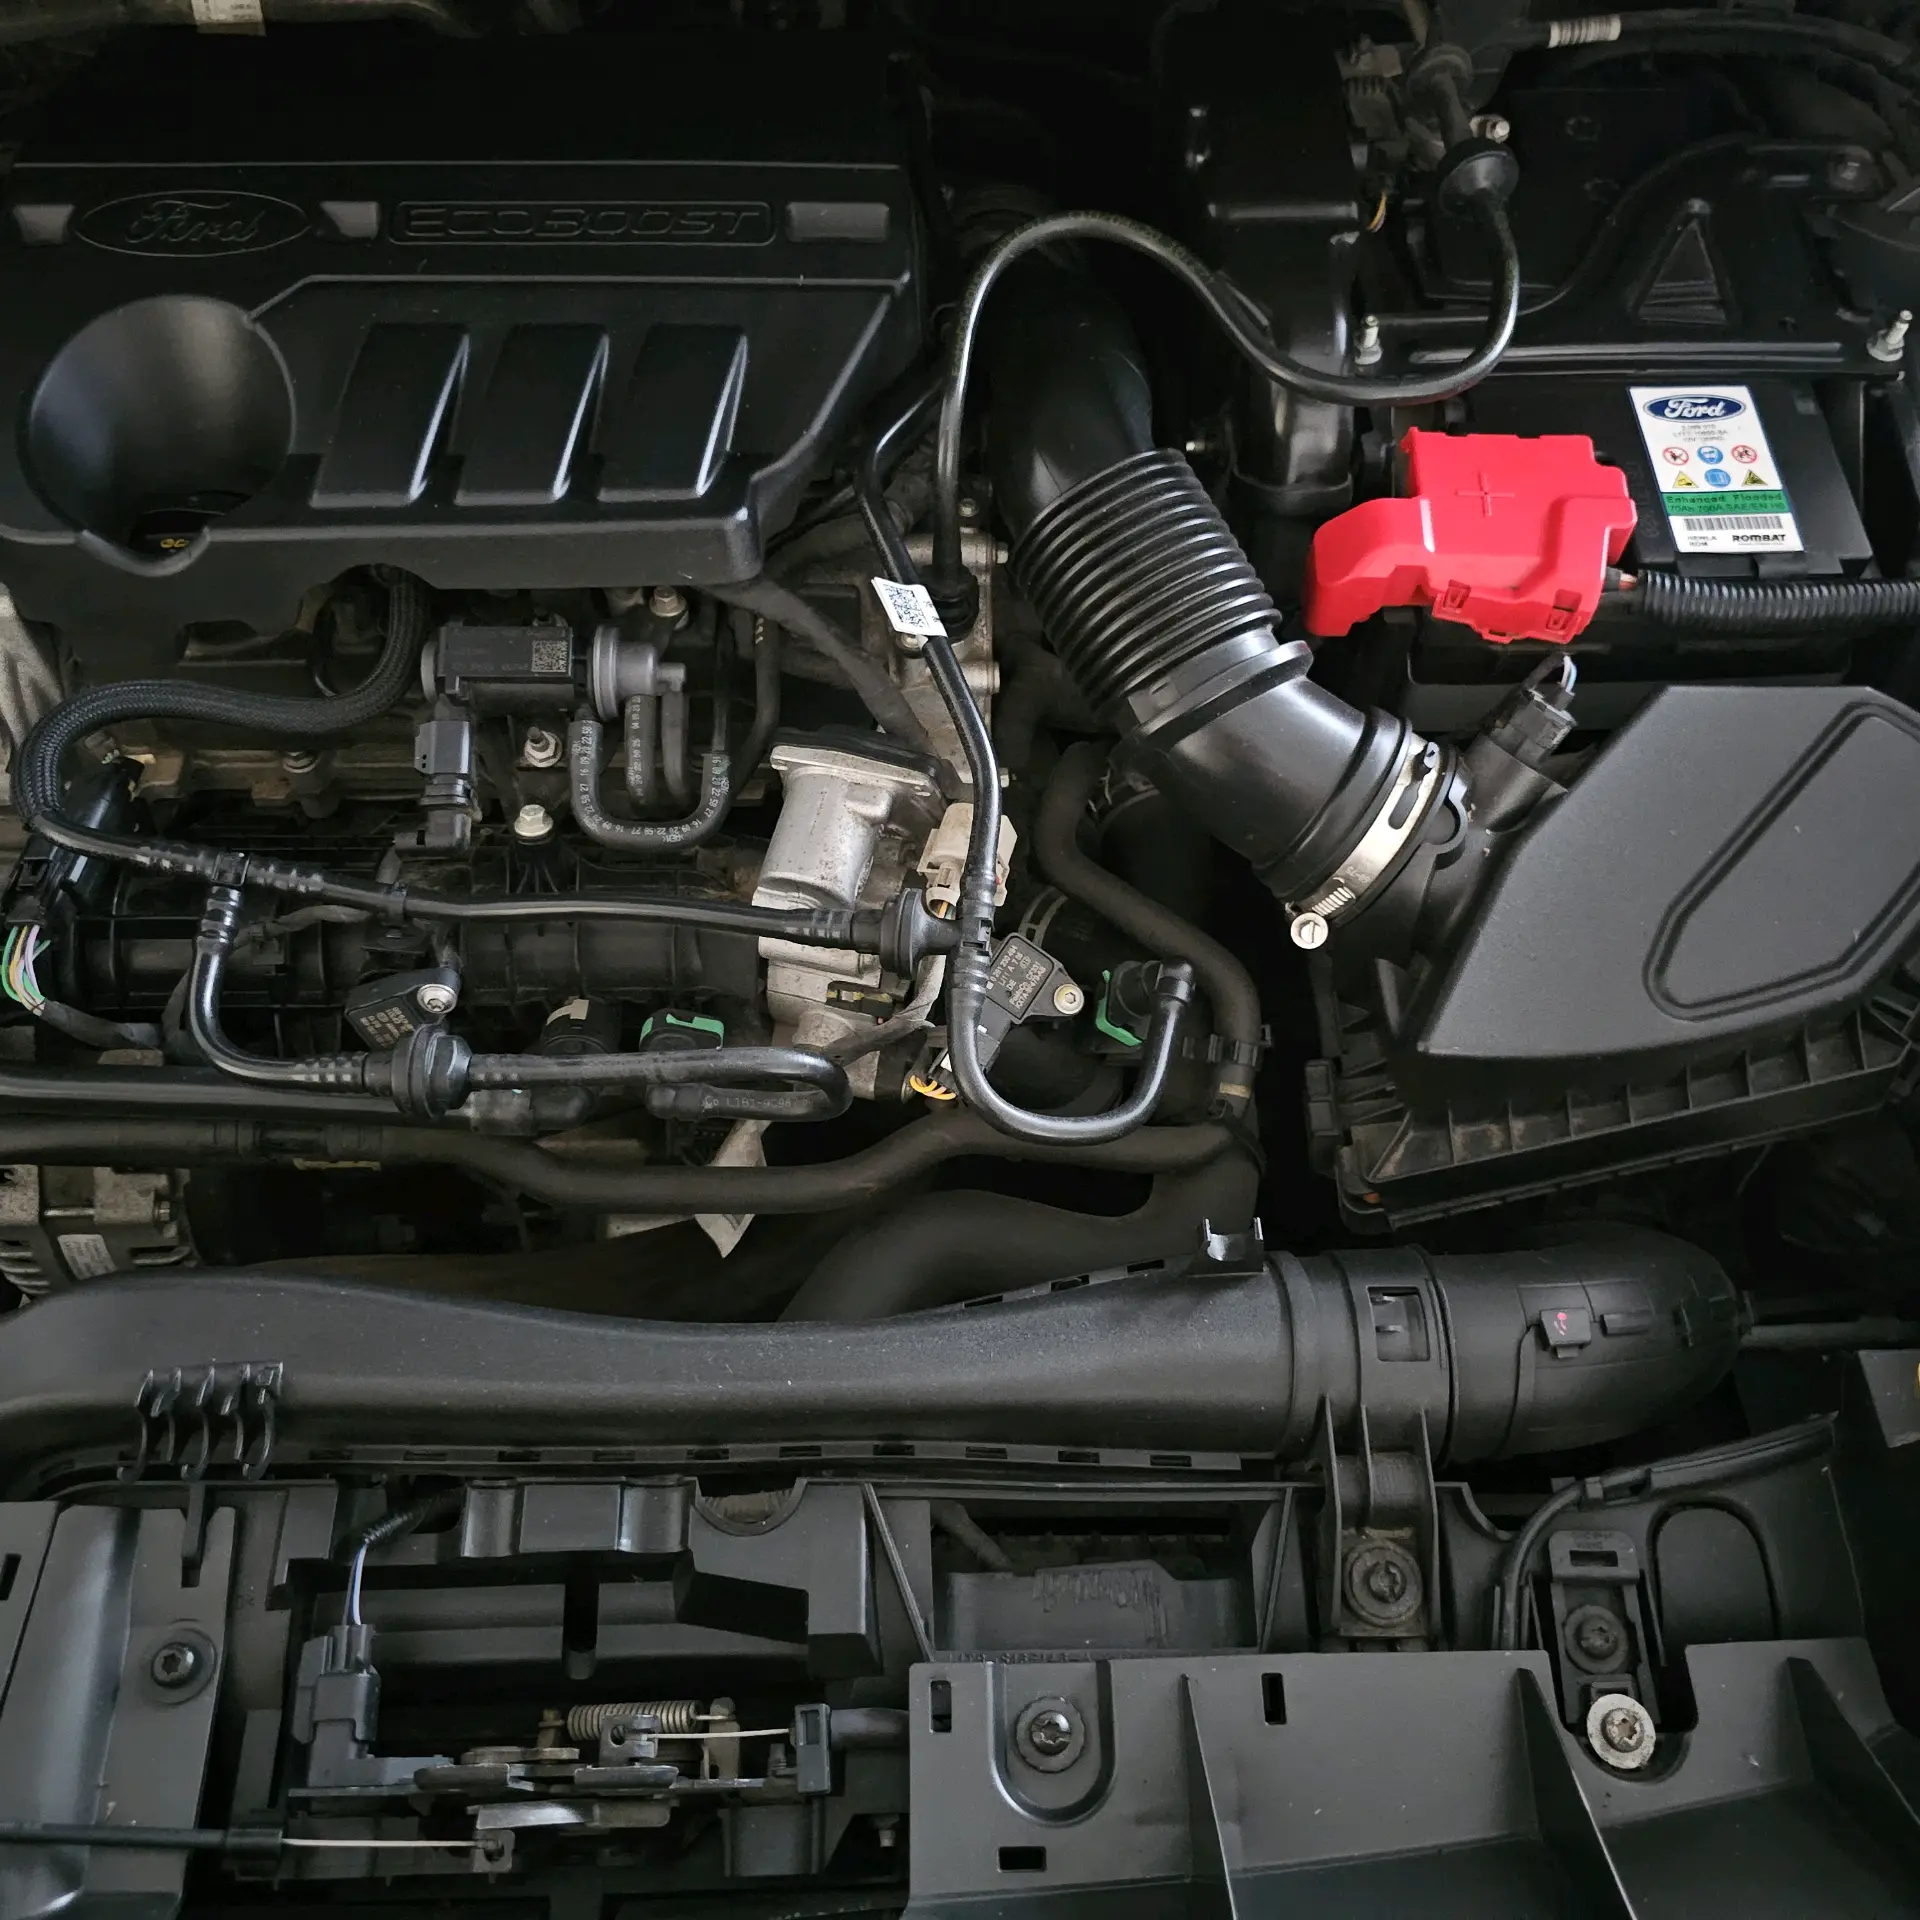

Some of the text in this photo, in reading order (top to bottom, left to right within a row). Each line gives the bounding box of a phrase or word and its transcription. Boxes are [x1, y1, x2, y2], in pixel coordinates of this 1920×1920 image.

[125, 199, 266, 243] Ford
[404, 207, 760, 237] ECOBOOST
[1664, 398, 1725, 419] Ford
[1666, 493, 1782, 503] Enhanced Flooded
[1732, 534, 1786, 542] ROMBAT
